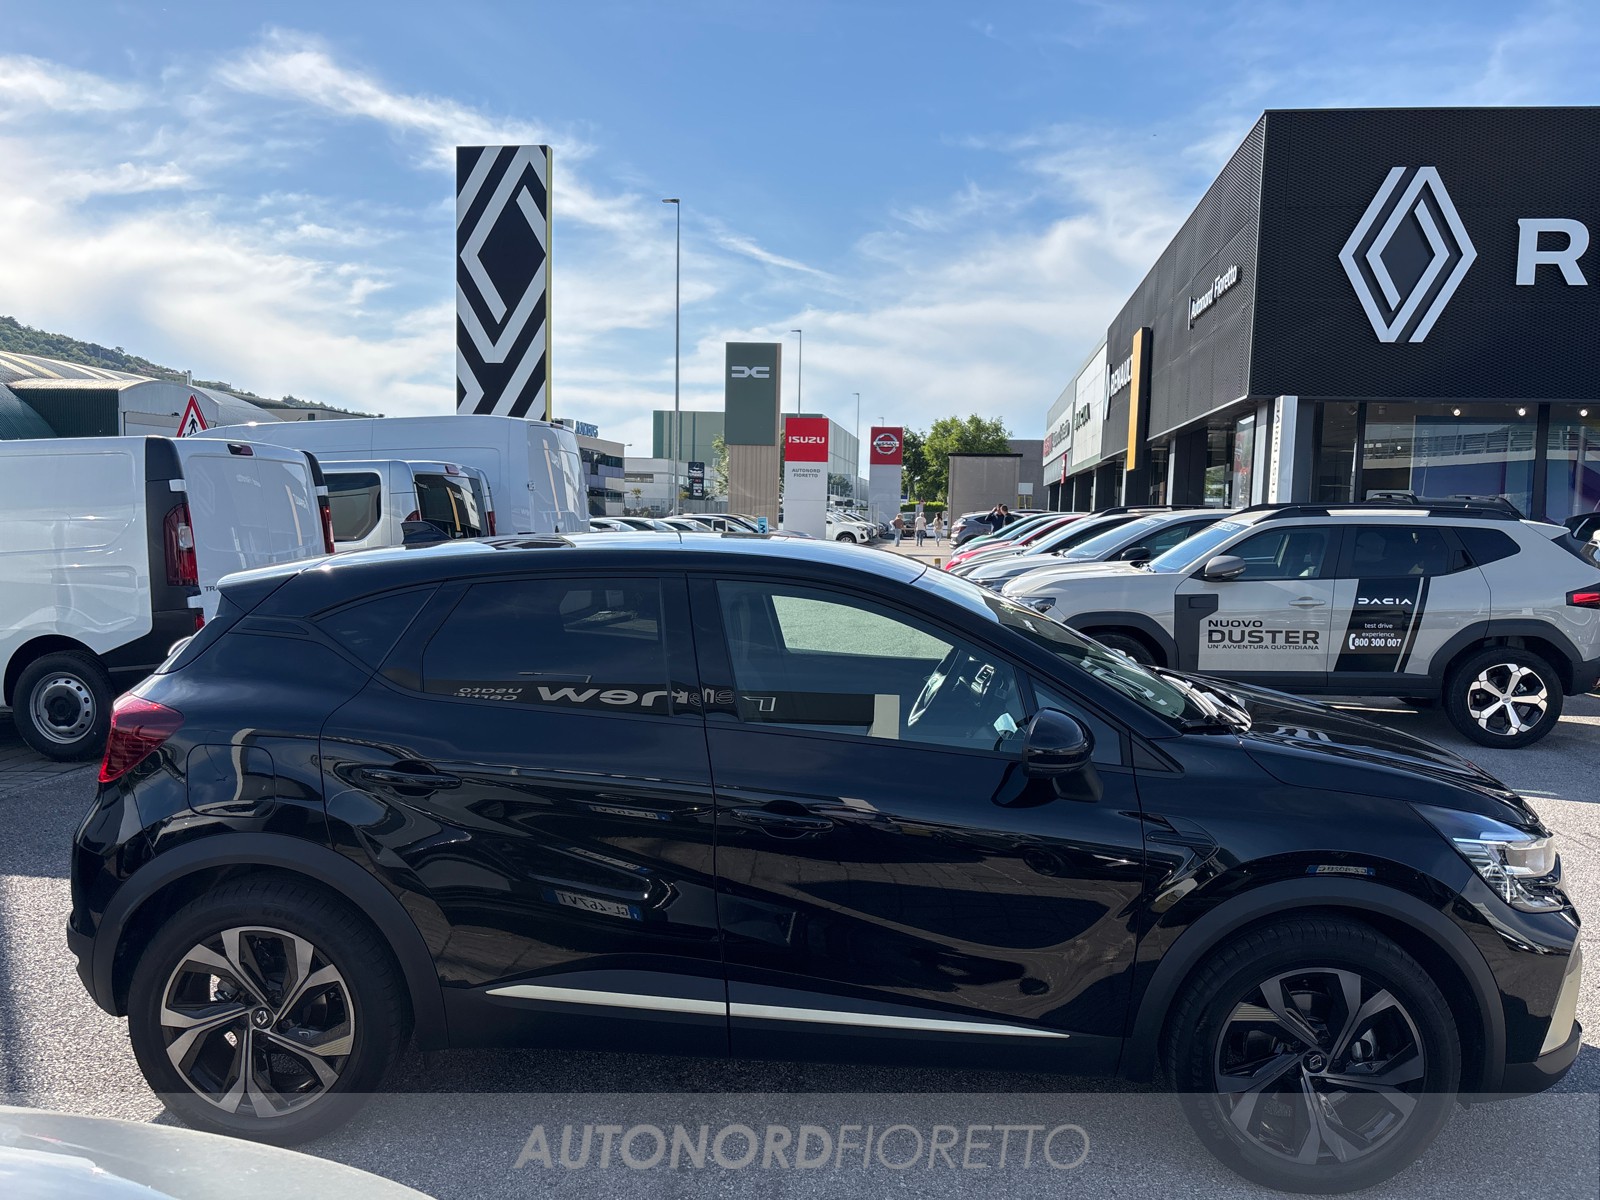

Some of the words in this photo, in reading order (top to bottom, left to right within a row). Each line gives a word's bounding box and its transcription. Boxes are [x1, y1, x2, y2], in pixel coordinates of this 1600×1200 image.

[1213, 264, 1238, 299] Fioretto
[788, 435, 825, 444] ISUZU
[1357, 597, 1413, 605] DACIA
[1207, 619, 1263, 628] NUOVO
[1207, 629, 1320, 645] DUSTER
[1361, 631, 1395, 639] experience
[1354, 638, 1369, 647] 800
[1370, 638, 1386, 647] 300
[1387, 638, 1402, 647] 007
